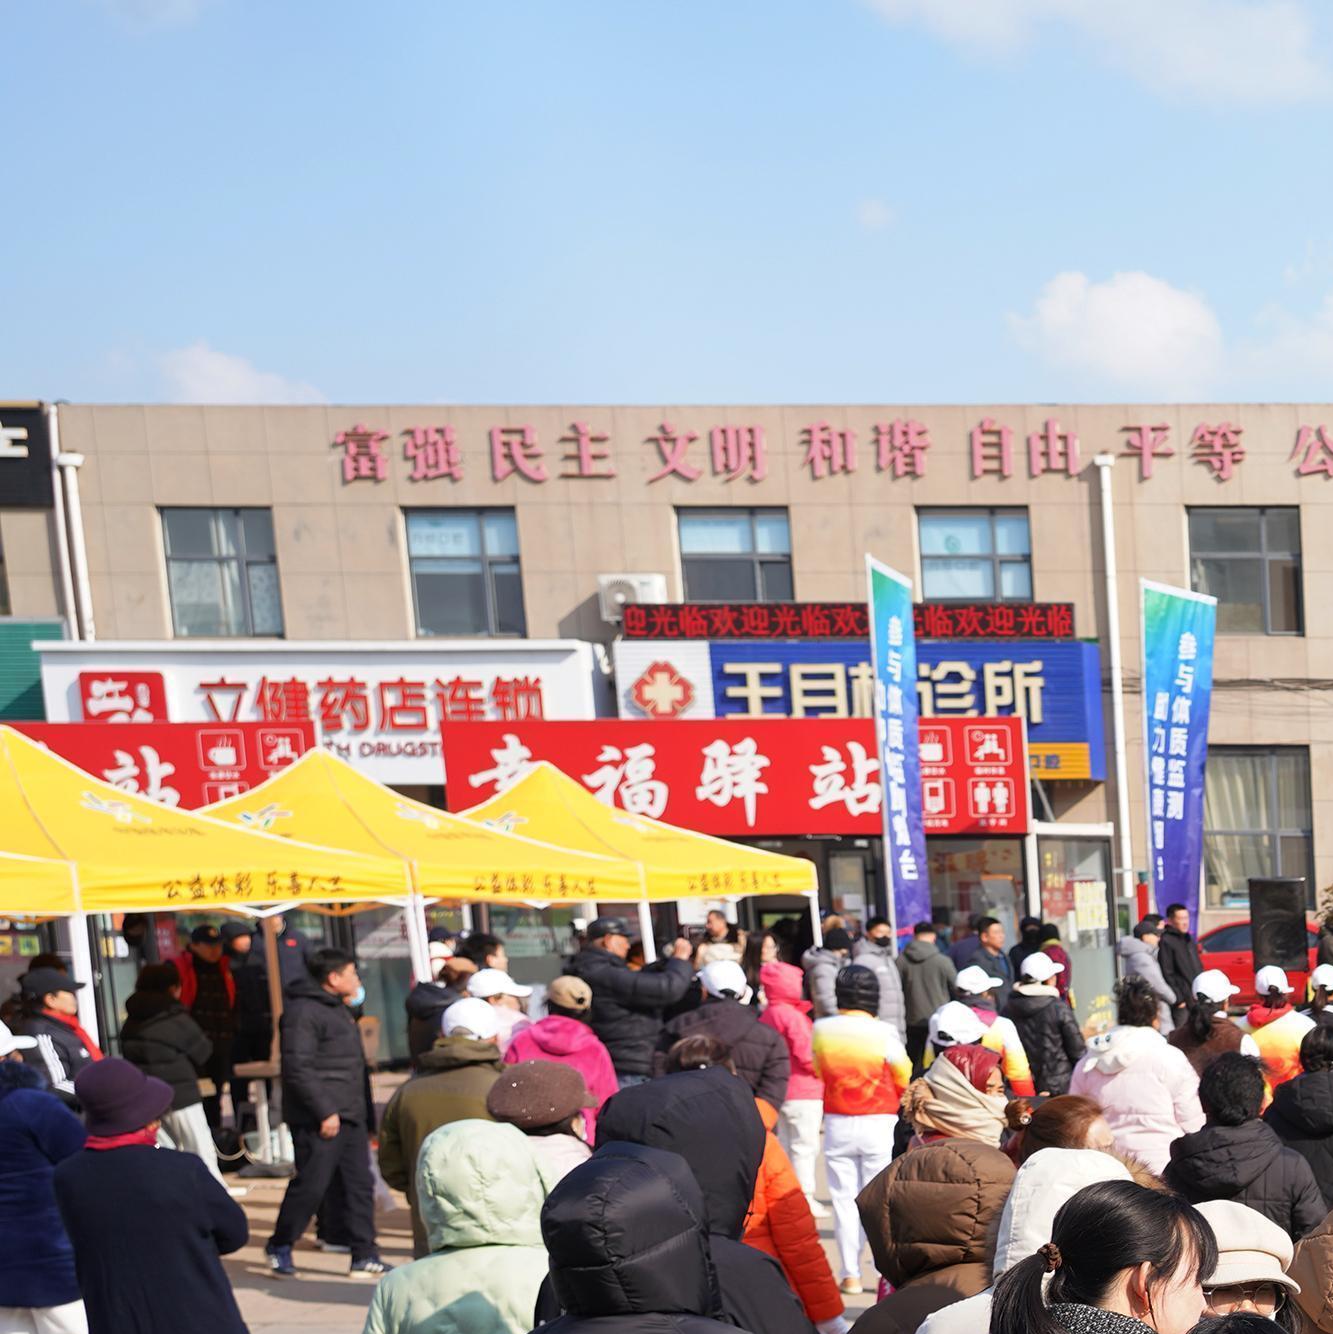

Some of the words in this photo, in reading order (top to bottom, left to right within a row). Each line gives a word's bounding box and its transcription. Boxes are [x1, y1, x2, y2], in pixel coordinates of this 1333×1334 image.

[336, 424, 463, 481] 富强
[491, 424, 616, 481] 民主
[647, 424, 766, 480] 文明
[803, 420, 931, 477] 和谐
[972, 418, 1080, 477] 自由
[1118, 421, 1246, 481] 平等
[197, 676, 544, 731] 立健药店连锁
[469, 734, 882, 826] 幸福驿站
